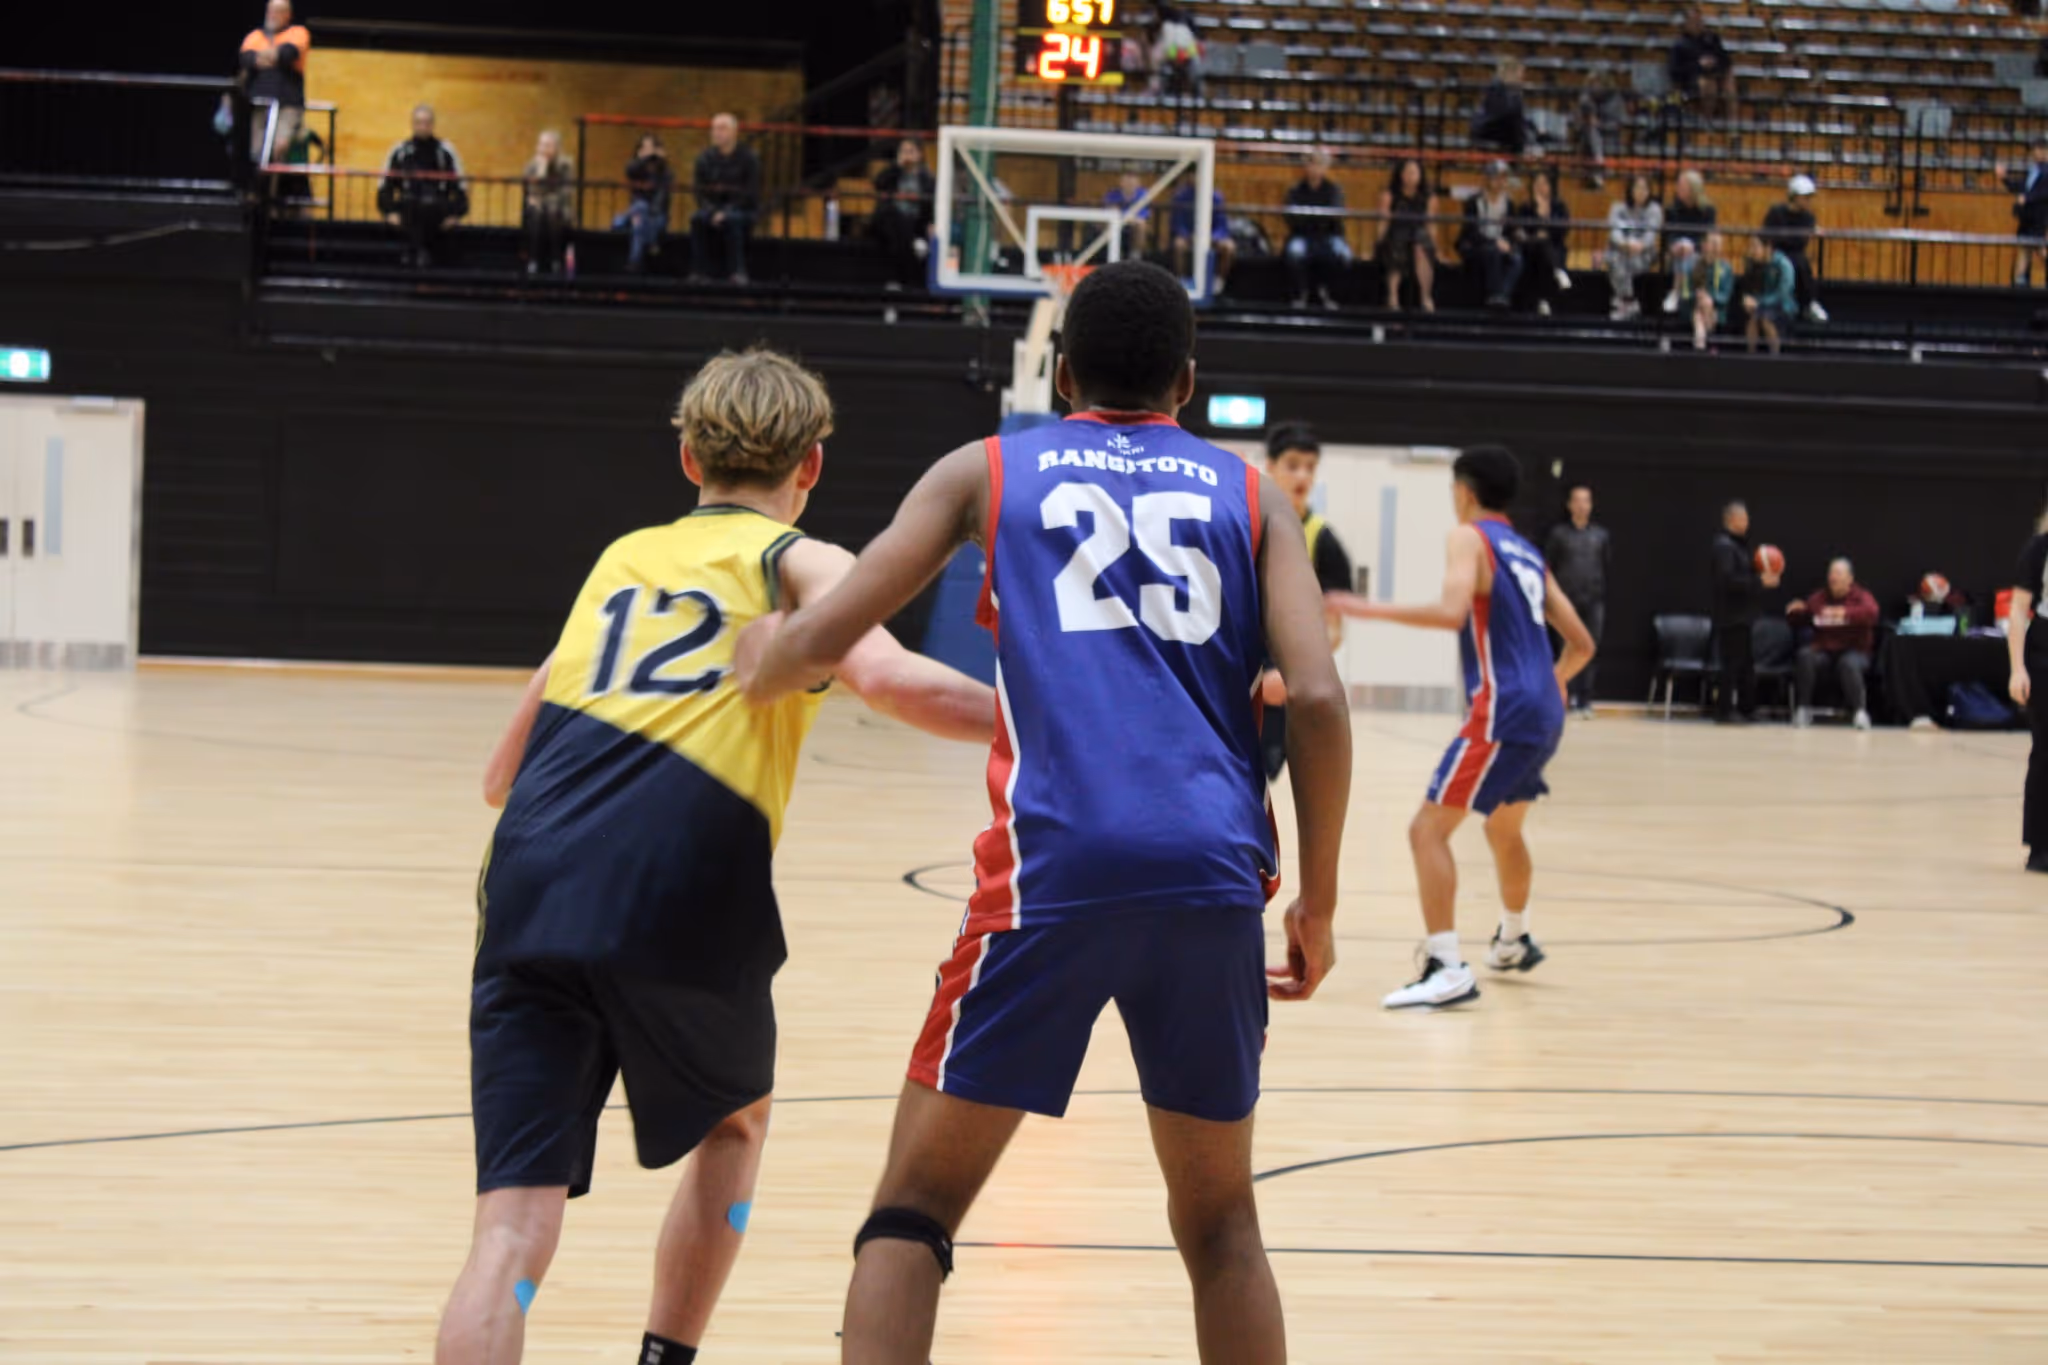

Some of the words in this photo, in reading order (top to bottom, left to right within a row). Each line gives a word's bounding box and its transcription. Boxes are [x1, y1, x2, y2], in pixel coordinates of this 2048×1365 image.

[1039, 32, 1101, 79] 24
[1039, 449, 1218, 485] RANGITOTO
[1040, 482, 1222, 644] 25
[590, 585, 731, 696] 12
